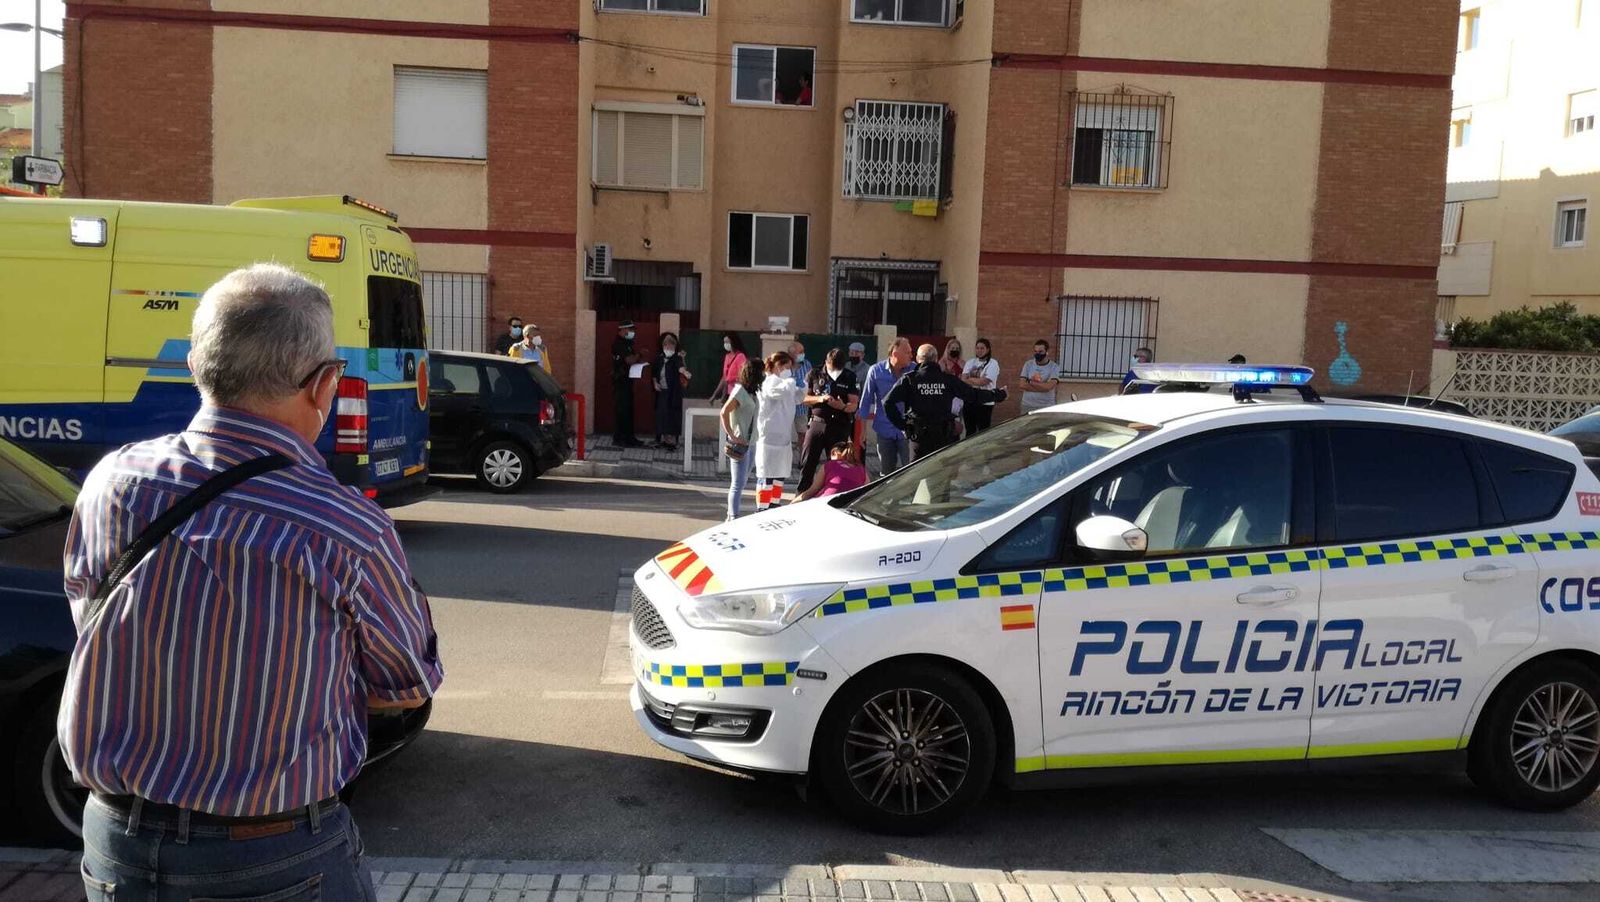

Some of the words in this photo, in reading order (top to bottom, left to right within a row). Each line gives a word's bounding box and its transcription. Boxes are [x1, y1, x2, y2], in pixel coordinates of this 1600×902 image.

[143, 299, 179, 311] ASM
[0, 416, 83, 441] NCIAS
[1069, 618, 1364, 676] POLICIA
[1360, 639, 1463, 667] LOCAL
[1060, 680, 1196, 717] RINCÓN
[1203, 687, 1253, 713] DE
[1257, 686, 1304, 711] LA
[1317, 678, 1462, 708] VICTORIA
